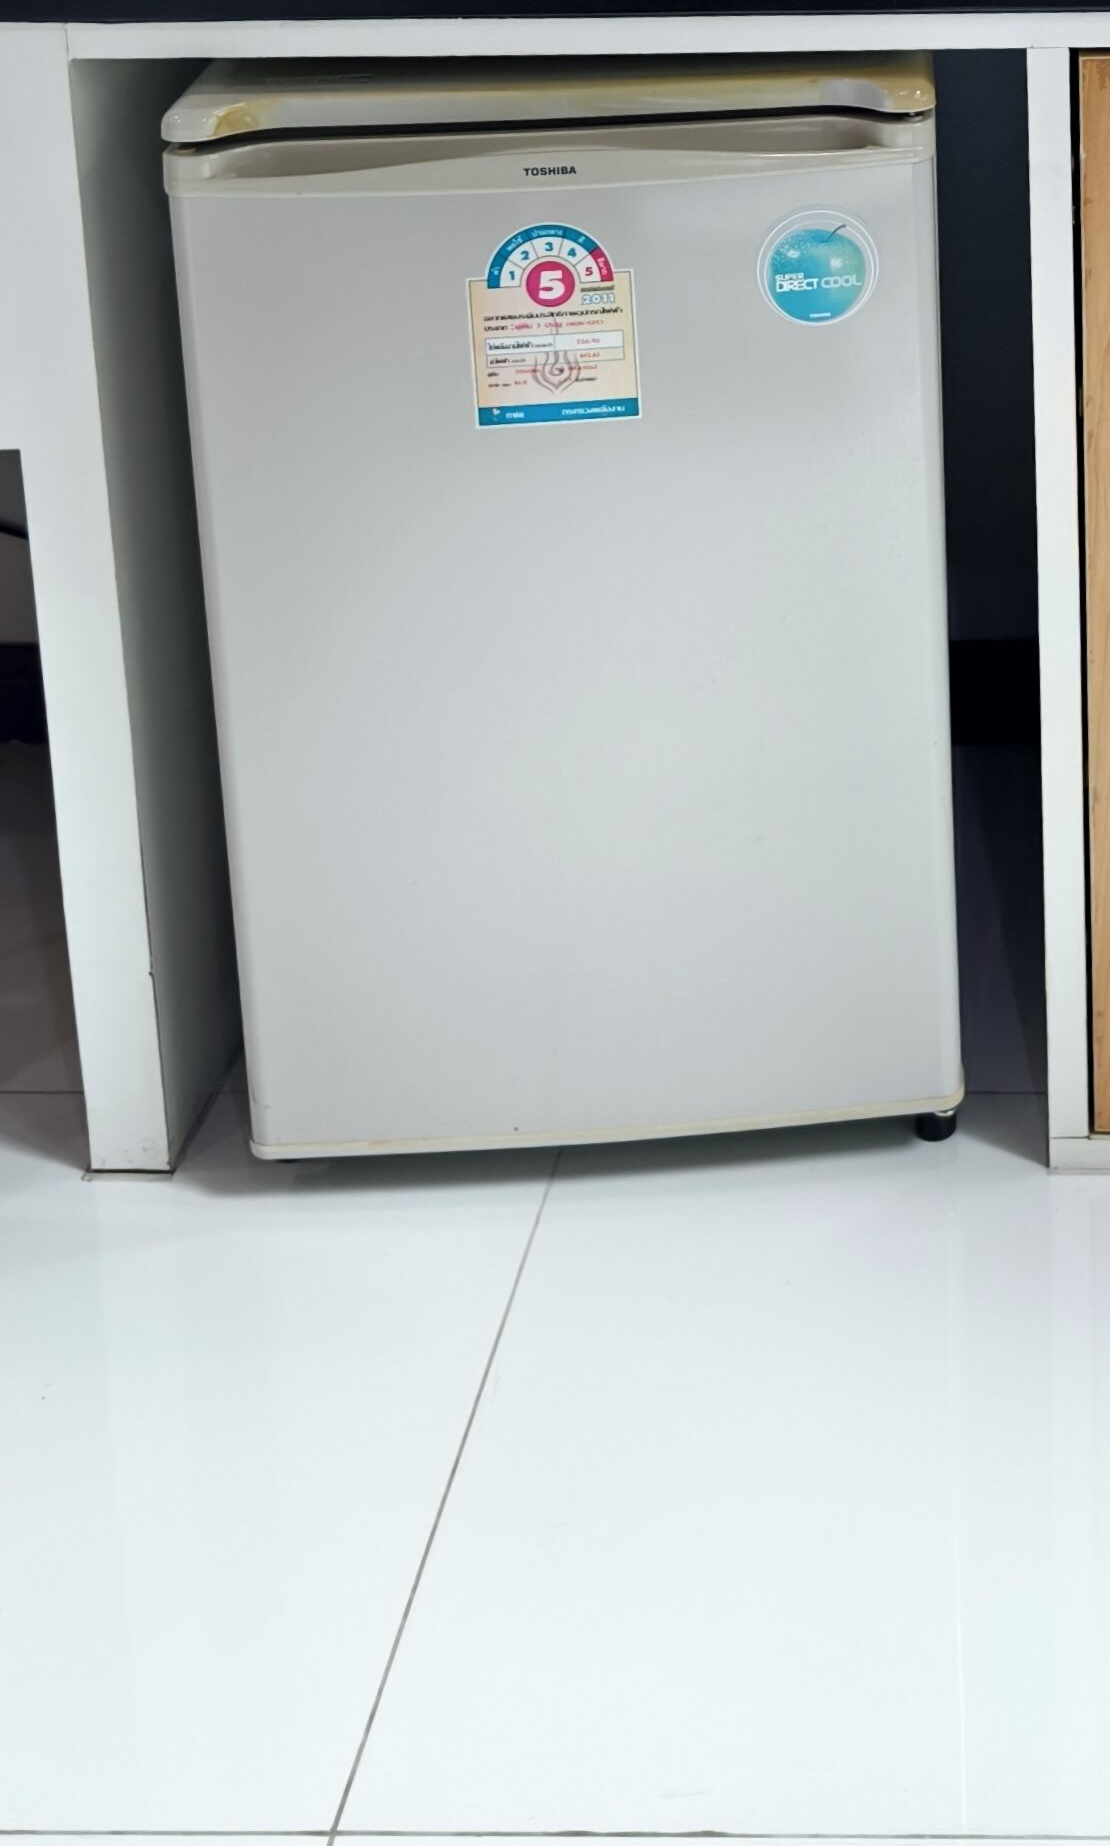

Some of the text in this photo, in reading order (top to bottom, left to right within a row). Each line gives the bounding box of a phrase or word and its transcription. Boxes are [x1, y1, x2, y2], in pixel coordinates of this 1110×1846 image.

[523, 165, 577, 177] TOSHIBA
[544, 241, 554, 252] 3
[521, 250, 530, 261] 2
[567, 247, 577, 258] 4
[508, 270, 516, 281] 1
[585, 266, 594, 277] 5
[538, 269, 566, 300] 5
[776, 274, 862, 293] DIRECT COOL
[581, 293, 615, 305] 2011
